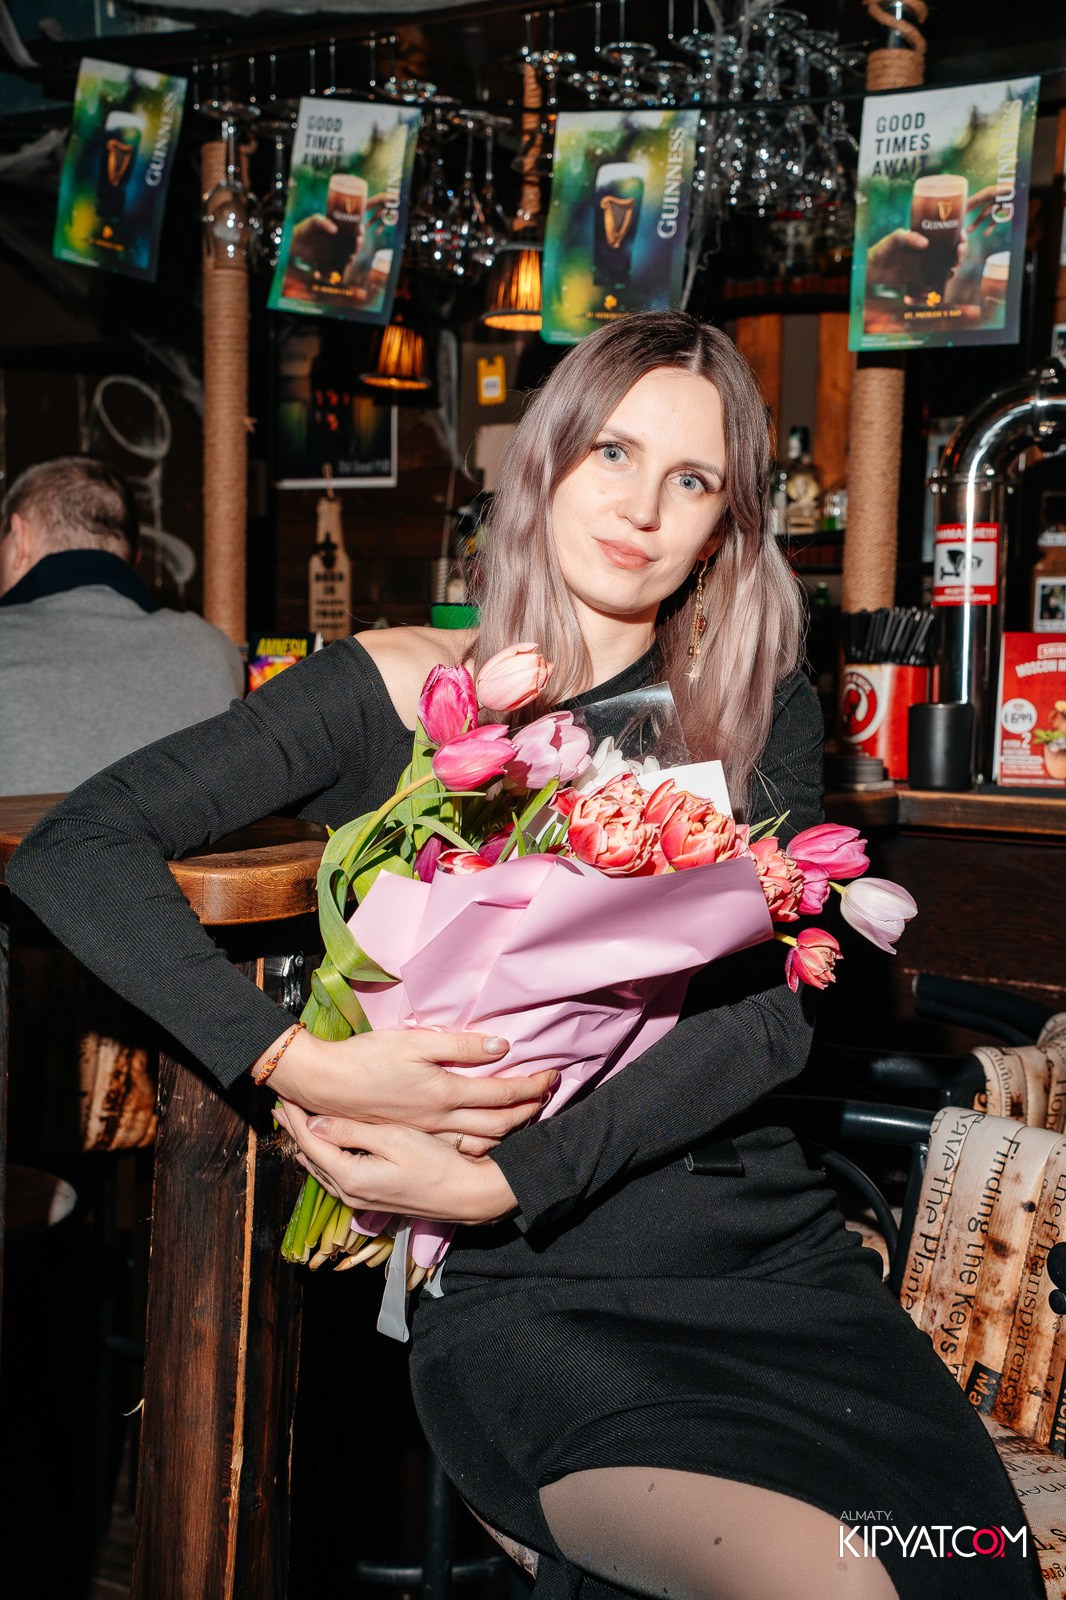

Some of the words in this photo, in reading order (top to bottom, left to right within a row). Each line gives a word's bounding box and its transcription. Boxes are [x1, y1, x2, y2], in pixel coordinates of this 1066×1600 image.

[304, 133, 345, 151] TIMES
[307, 114, 343, 132] GOOD
[875, 112, 926, 134] GOOD
[875, 133, 931, 155] TIMES
[656, 126, 686, 240] GUINNESS
[872, 155, 930, 177] AWAIT
[925, 1176, 953, 1225] the
[967, 1136, 1021, 1236] Finding
[903, 1231, 941, 1312] Plane
[959, 1242, 986, 1286] the
[940, 1292, 976, 1354] Keys
